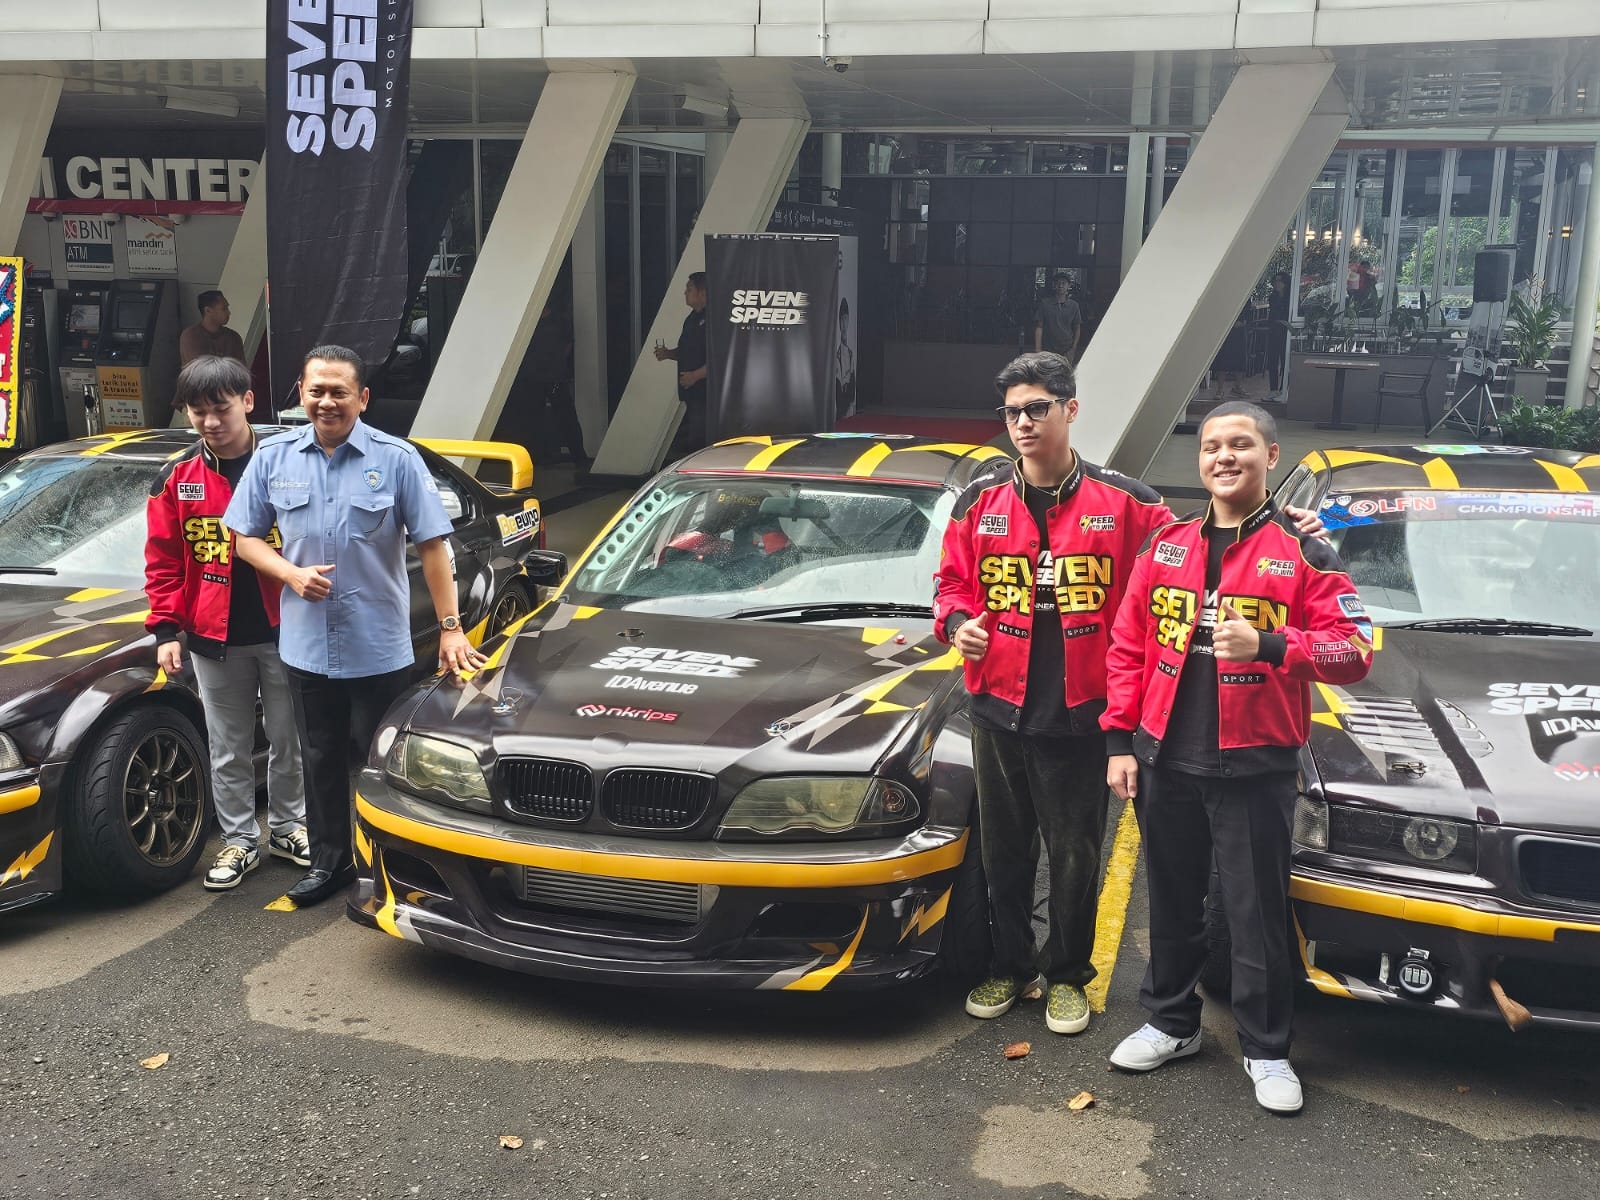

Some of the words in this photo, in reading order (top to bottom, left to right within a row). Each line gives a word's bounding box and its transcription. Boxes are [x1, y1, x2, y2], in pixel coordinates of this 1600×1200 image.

[385, 33, 396, 108] MOTOR
[65, 156, 260, 201] CENTER
[79, 220, 110, 240] BNI
[127, 239, 164, 249] mandiri
[67, 246, 88, 260] ATM
[731, 290, 806, 306] SEVEN
[729, 306, 806, 324] SPEED
[179, 484, 203, 493] SEVEN
[1377, 497, 1437, 514] LFN
[981, 516, 1006, 527] SEVEN
[1158, 543, 1186, 559] SEVEN
[1067, 625, 1097, 636] SPORT
[608, 646, 760, 668] SEVEN
[590, 657, 748, 678] SPEED
[604, 675, 699, 694] IDAvenue
[1223, 675, 1260, 683] SPORT
[606, 706, 678, 721] nkrips
[1488, 697, 1600, 715] SPE
